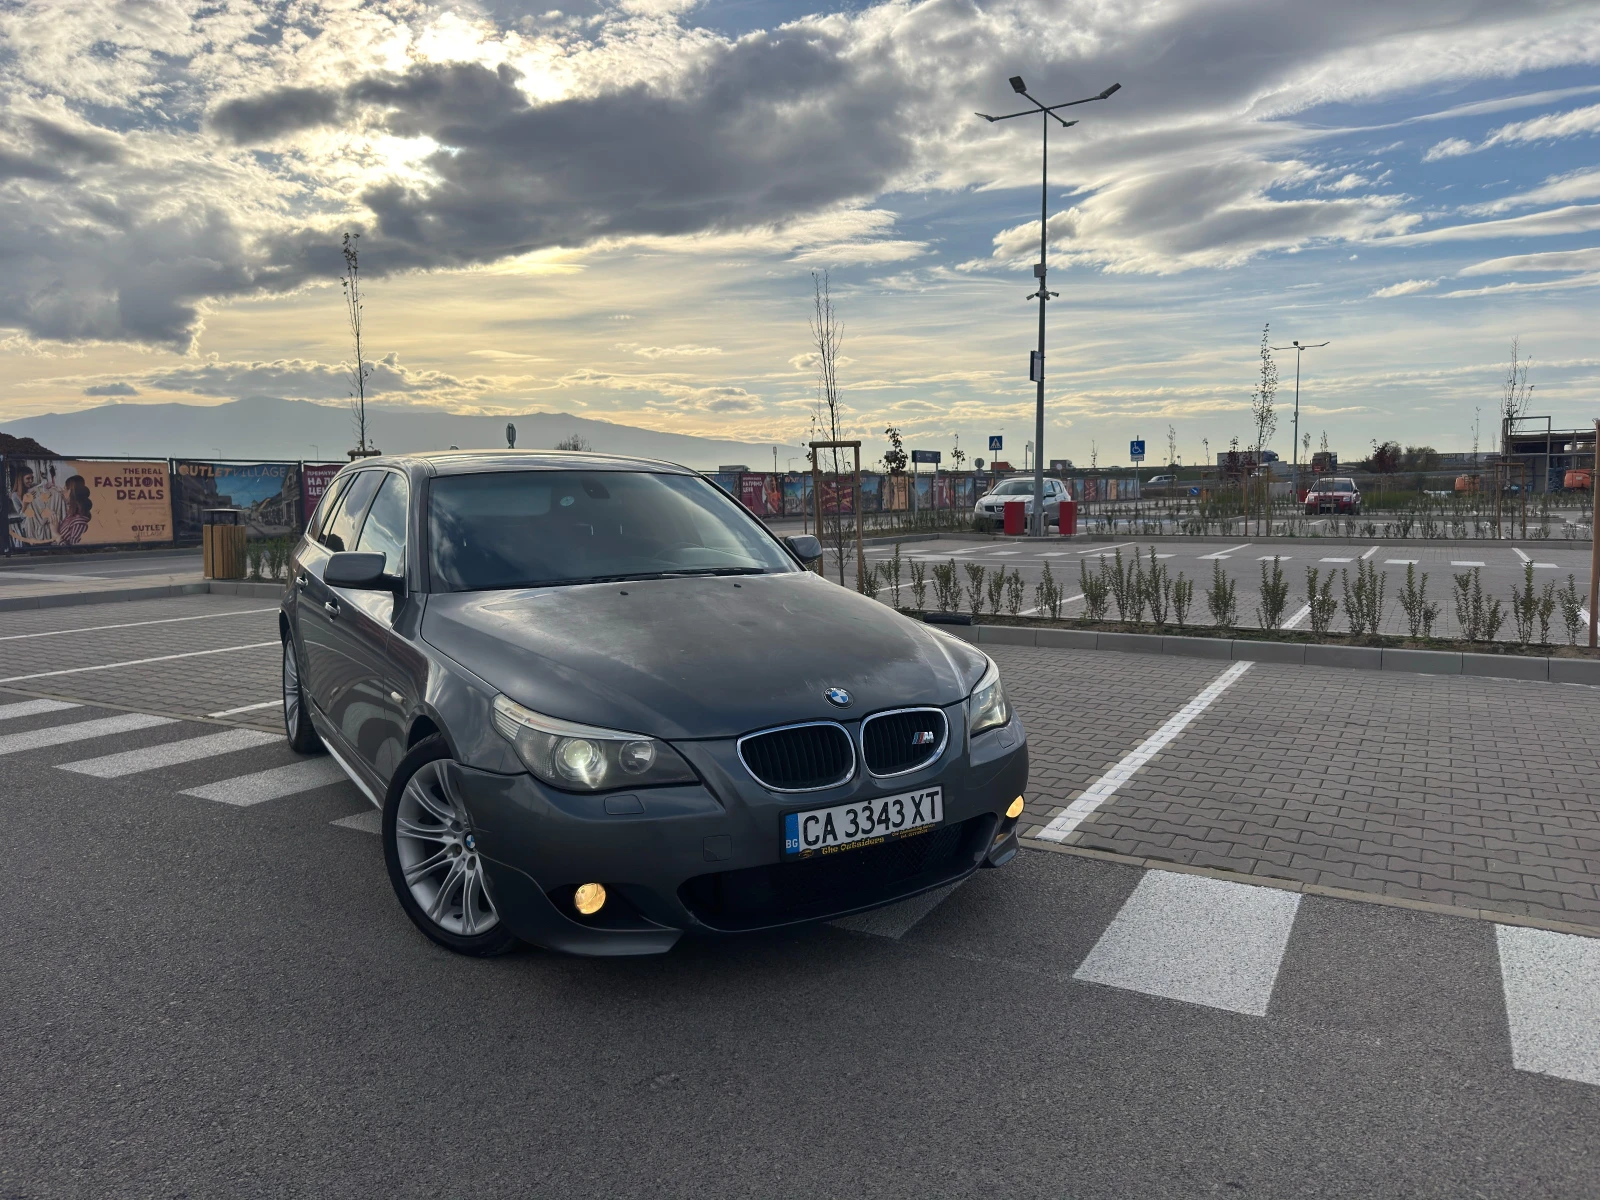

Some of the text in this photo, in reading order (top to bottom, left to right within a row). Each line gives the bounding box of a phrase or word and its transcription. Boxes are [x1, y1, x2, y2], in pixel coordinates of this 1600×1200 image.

[178, 464, 286, 478] OUTLET VILLAGE
[94, 477, 163, 487] FASHION
[307, 477, 322, 485] НА
[117, 490, 164, 500] DEALS
[132, 524, 166, 532] OUTLET
[803, 790, 939, 846] CA 3343 XT
[785, 839, 798, 848] BG
[821, 838, 884, 855] The Outsiders
